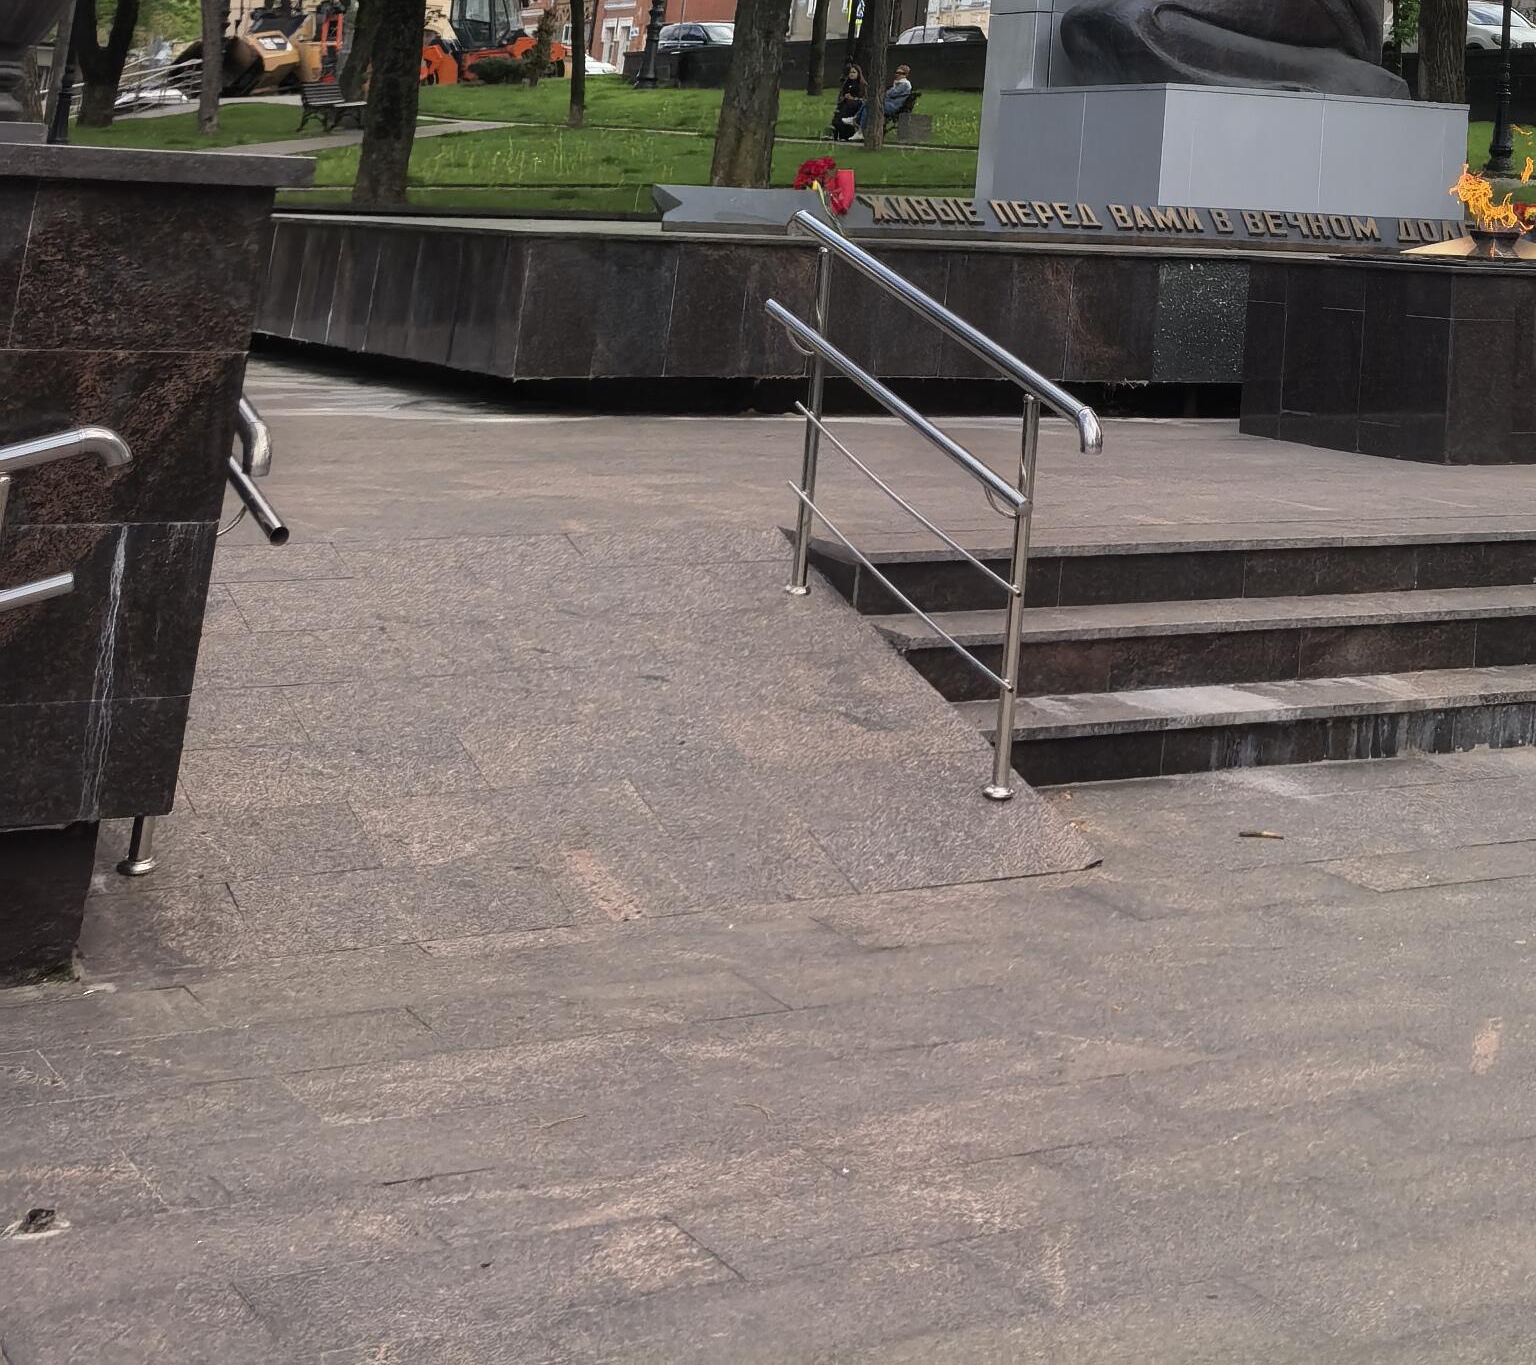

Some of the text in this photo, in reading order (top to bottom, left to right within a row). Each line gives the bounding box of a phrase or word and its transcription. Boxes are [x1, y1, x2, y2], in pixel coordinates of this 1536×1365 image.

[857, 194, 1477, 243] ЖИВЫЕ ПЕРЕД ВАМИ В ВЕЧНОМ ДОЛГ
